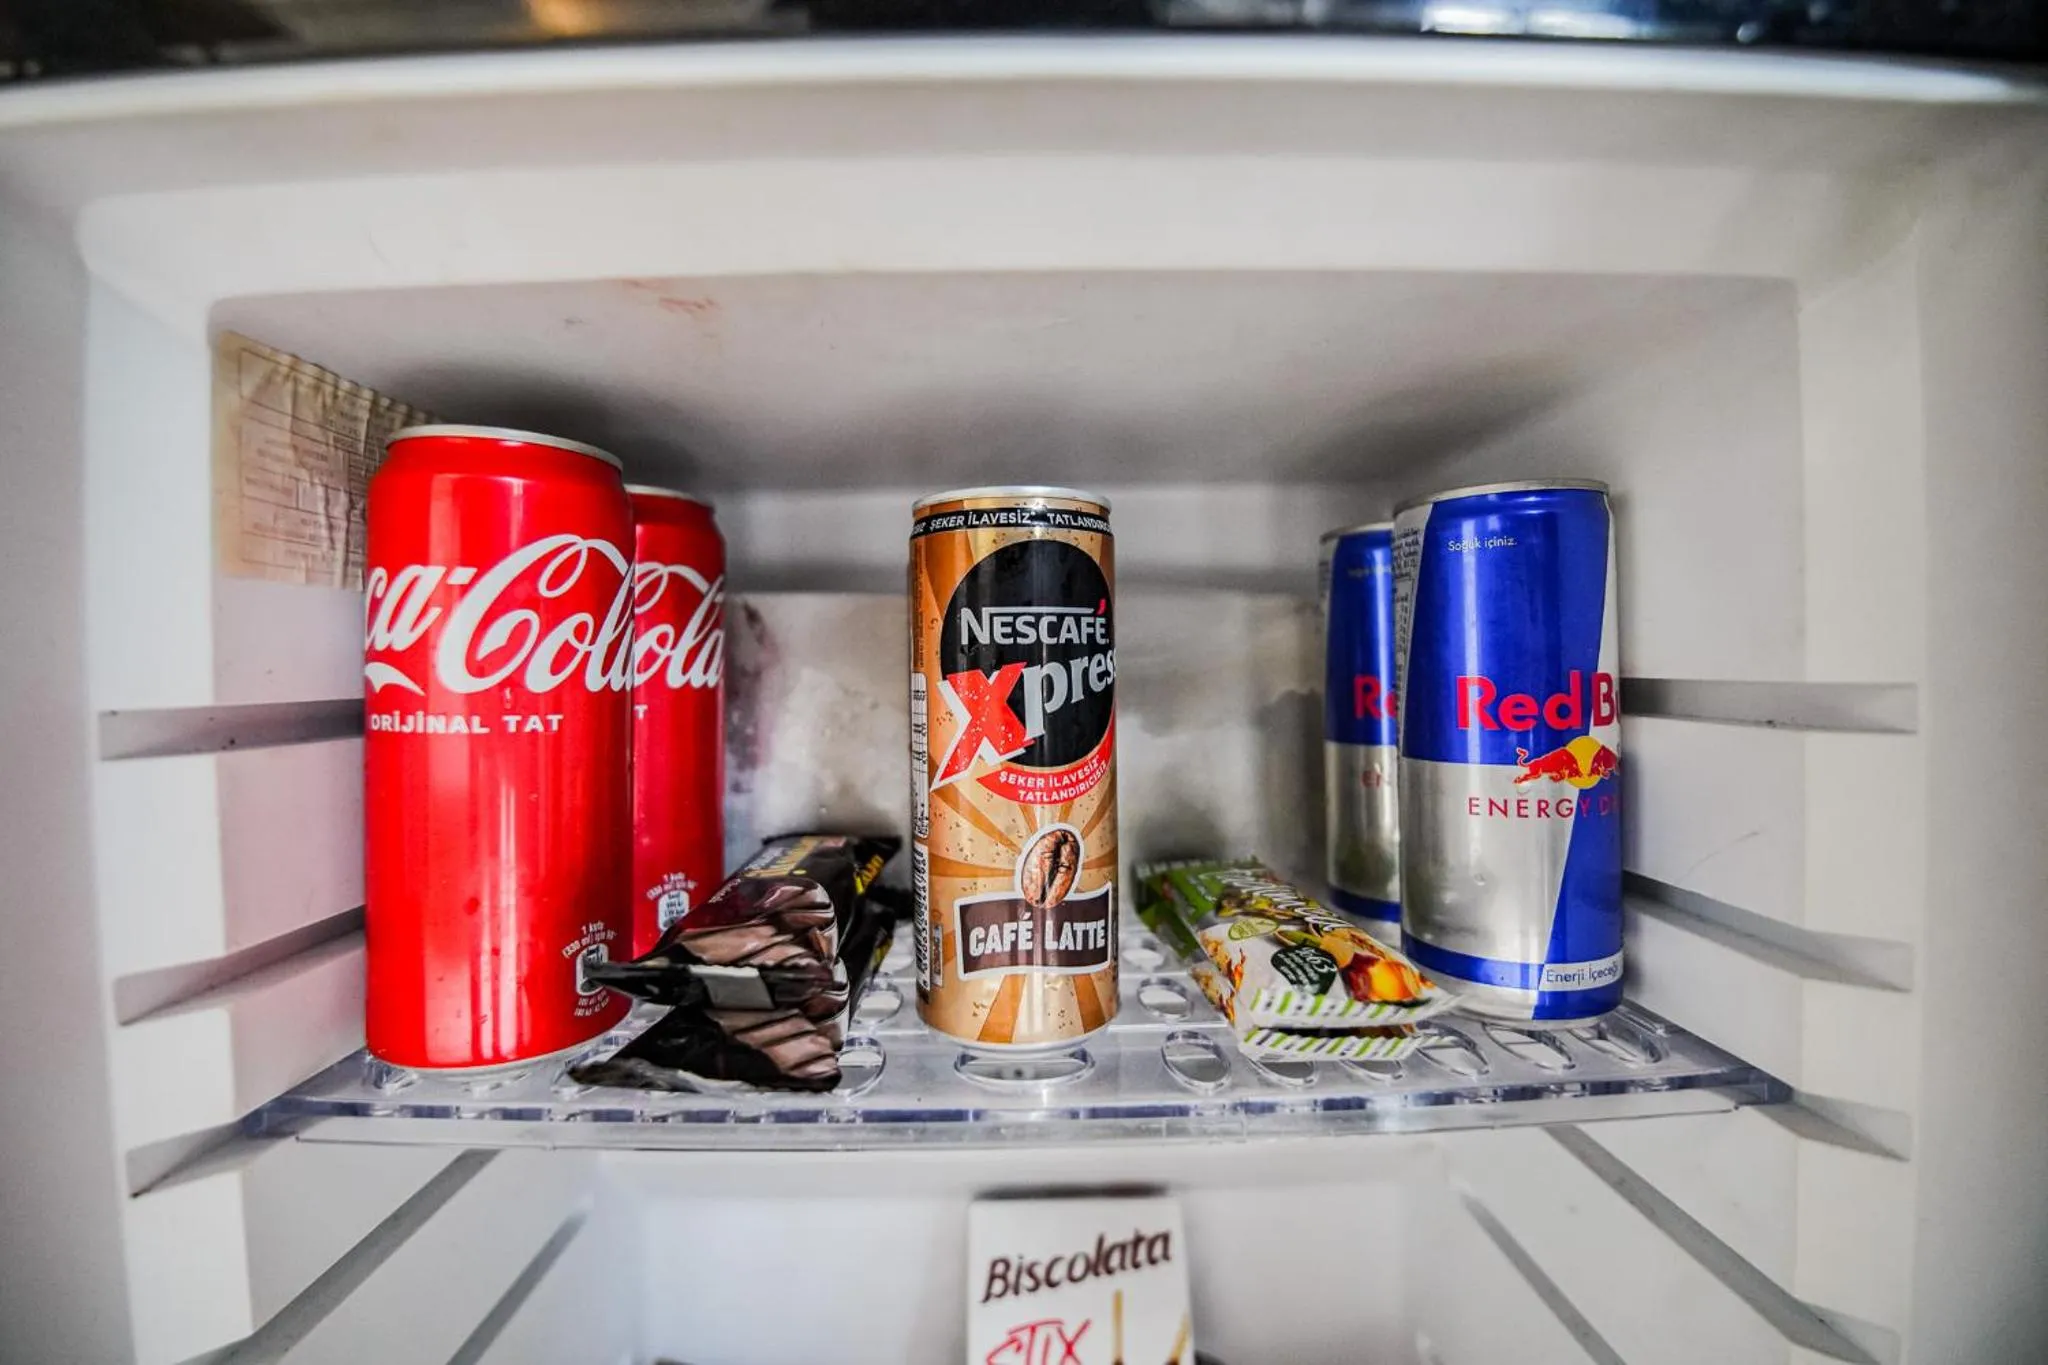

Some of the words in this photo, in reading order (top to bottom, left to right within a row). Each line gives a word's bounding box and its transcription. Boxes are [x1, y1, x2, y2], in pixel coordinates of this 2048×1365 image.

[960, 599, 1109, 645] NESCAFÉ
[503, 714, 563, 733] TAT
[930, 648, 1117, 792] Xpres
[1456, 670, 1582, 731] Red
[1468, 797, 1591, 818] ENERGY
[969, 911, 1033, 957] CAFÉ
[1044, 919, 1107, 951] LATTE
[980, 1228, 1172, 1304] Biscolata
